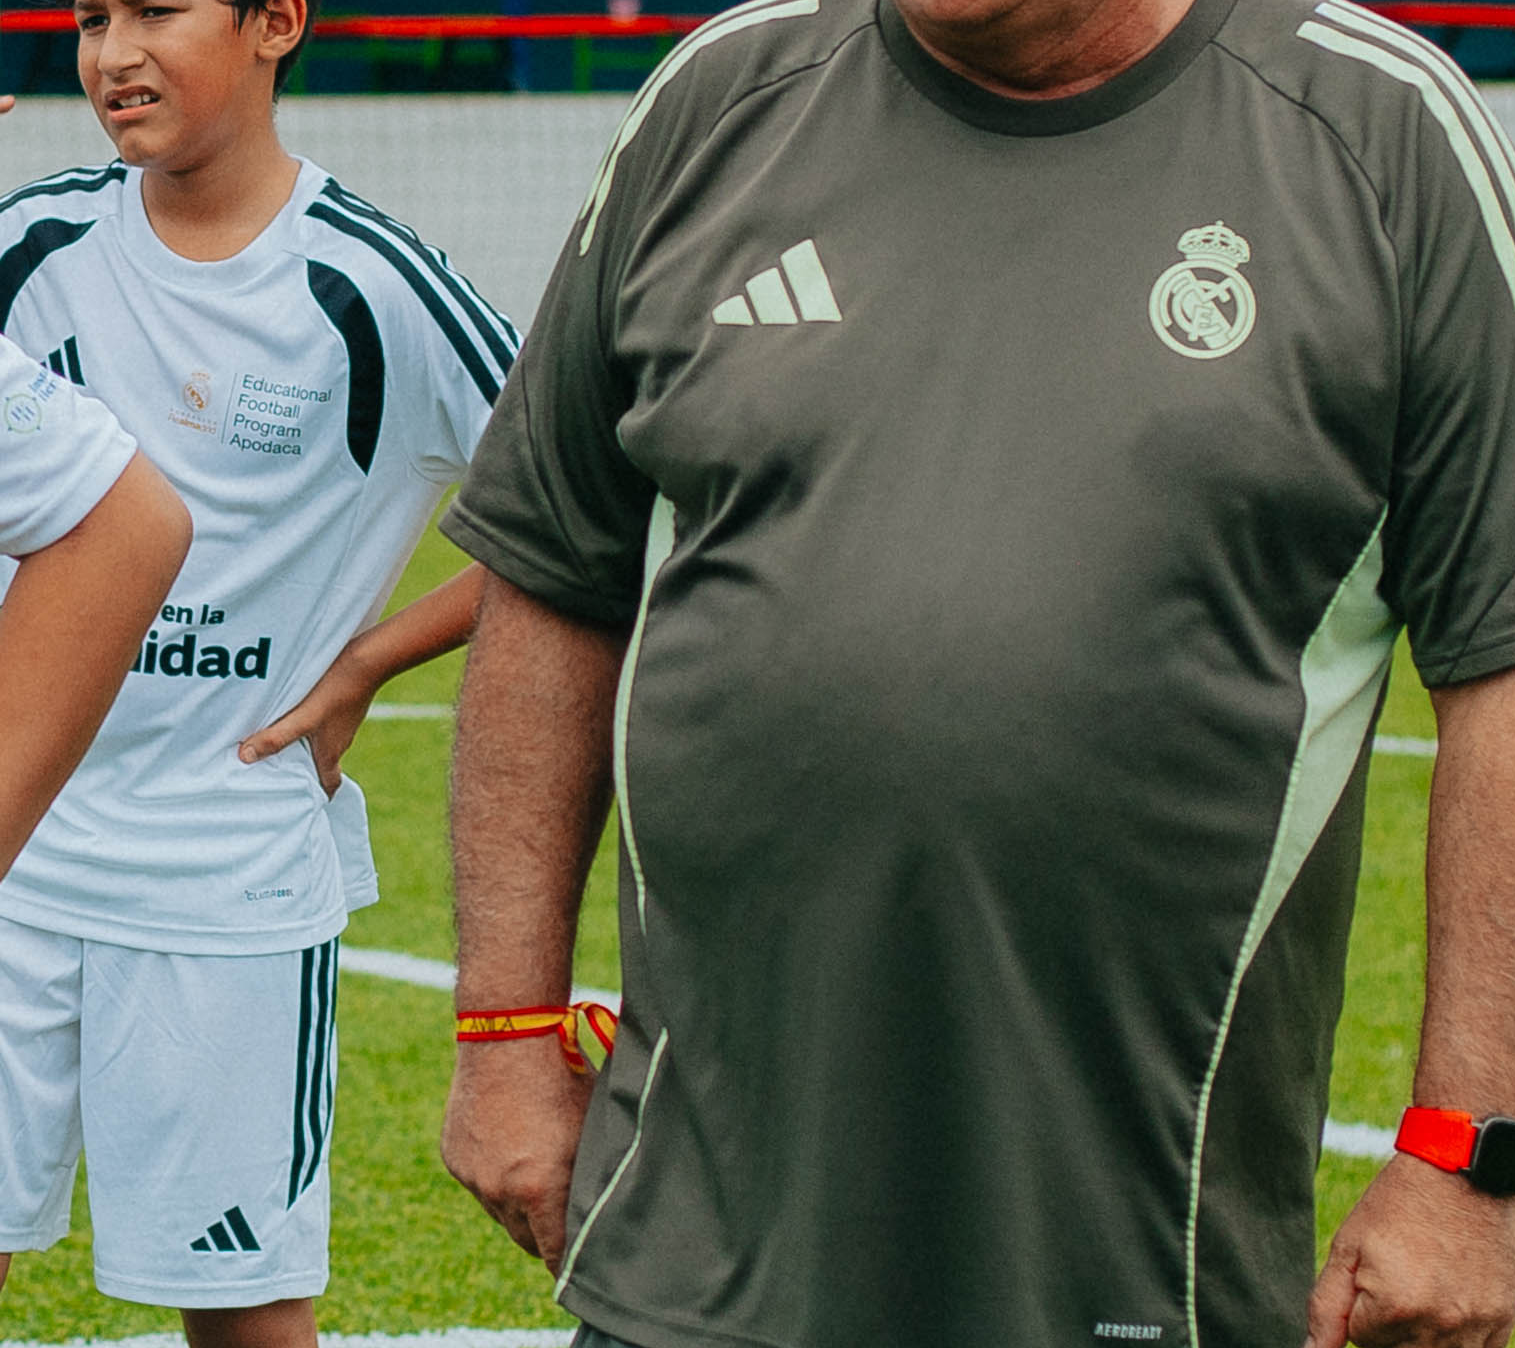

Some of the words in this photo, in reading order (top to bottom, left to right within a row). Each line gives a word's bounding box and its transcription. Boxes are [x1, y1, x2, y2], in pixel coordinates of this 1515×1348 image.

[242, 373, 333, 403] Educational
[237, 393, 301, 419] Football
[233, 413, 302, 438] Program
[229, 433, 302, 455] Apodaca
[161, 604, 194, 625] en
[199, 604, 225, 625] la
[1093, 1322, 1163, 1340] AEROREADY
